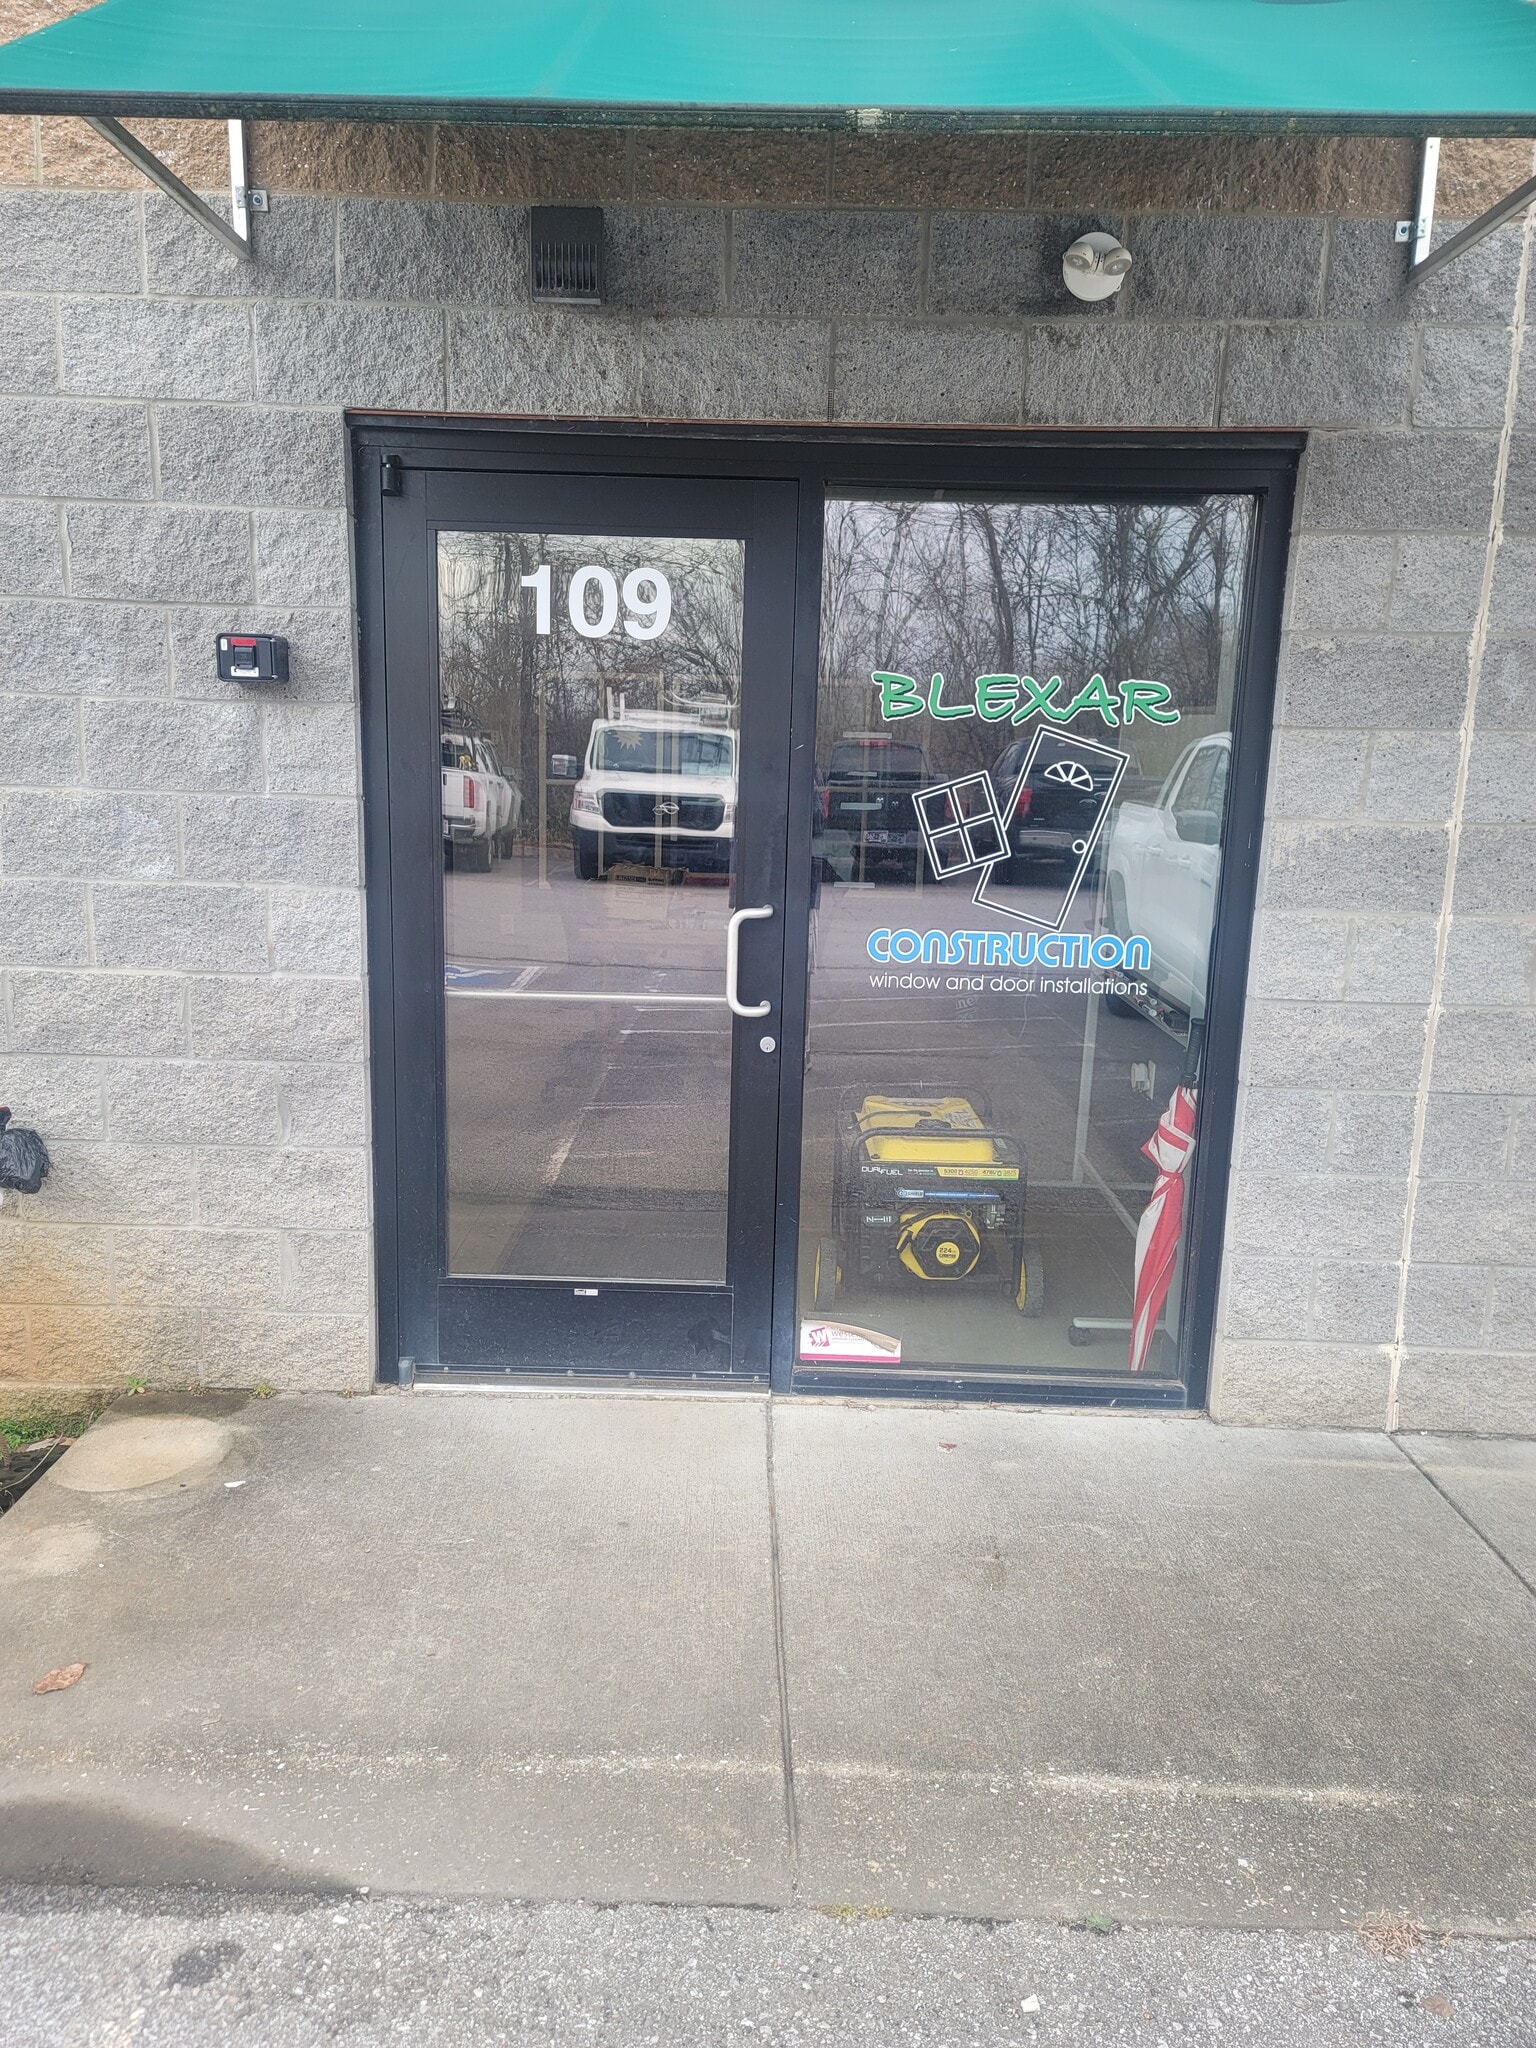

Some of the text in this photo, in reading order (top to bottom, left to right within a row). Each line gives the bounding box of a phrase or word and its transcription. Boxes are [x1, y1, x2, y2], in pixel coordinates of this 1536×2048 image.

[521, 564, 672, 641] 109
[872, 671, 1180, 726] BLEXAR
[867, 929, 1151, 970] CONSTRUCTION
[868, 972, 1148, 996] window and door installations
